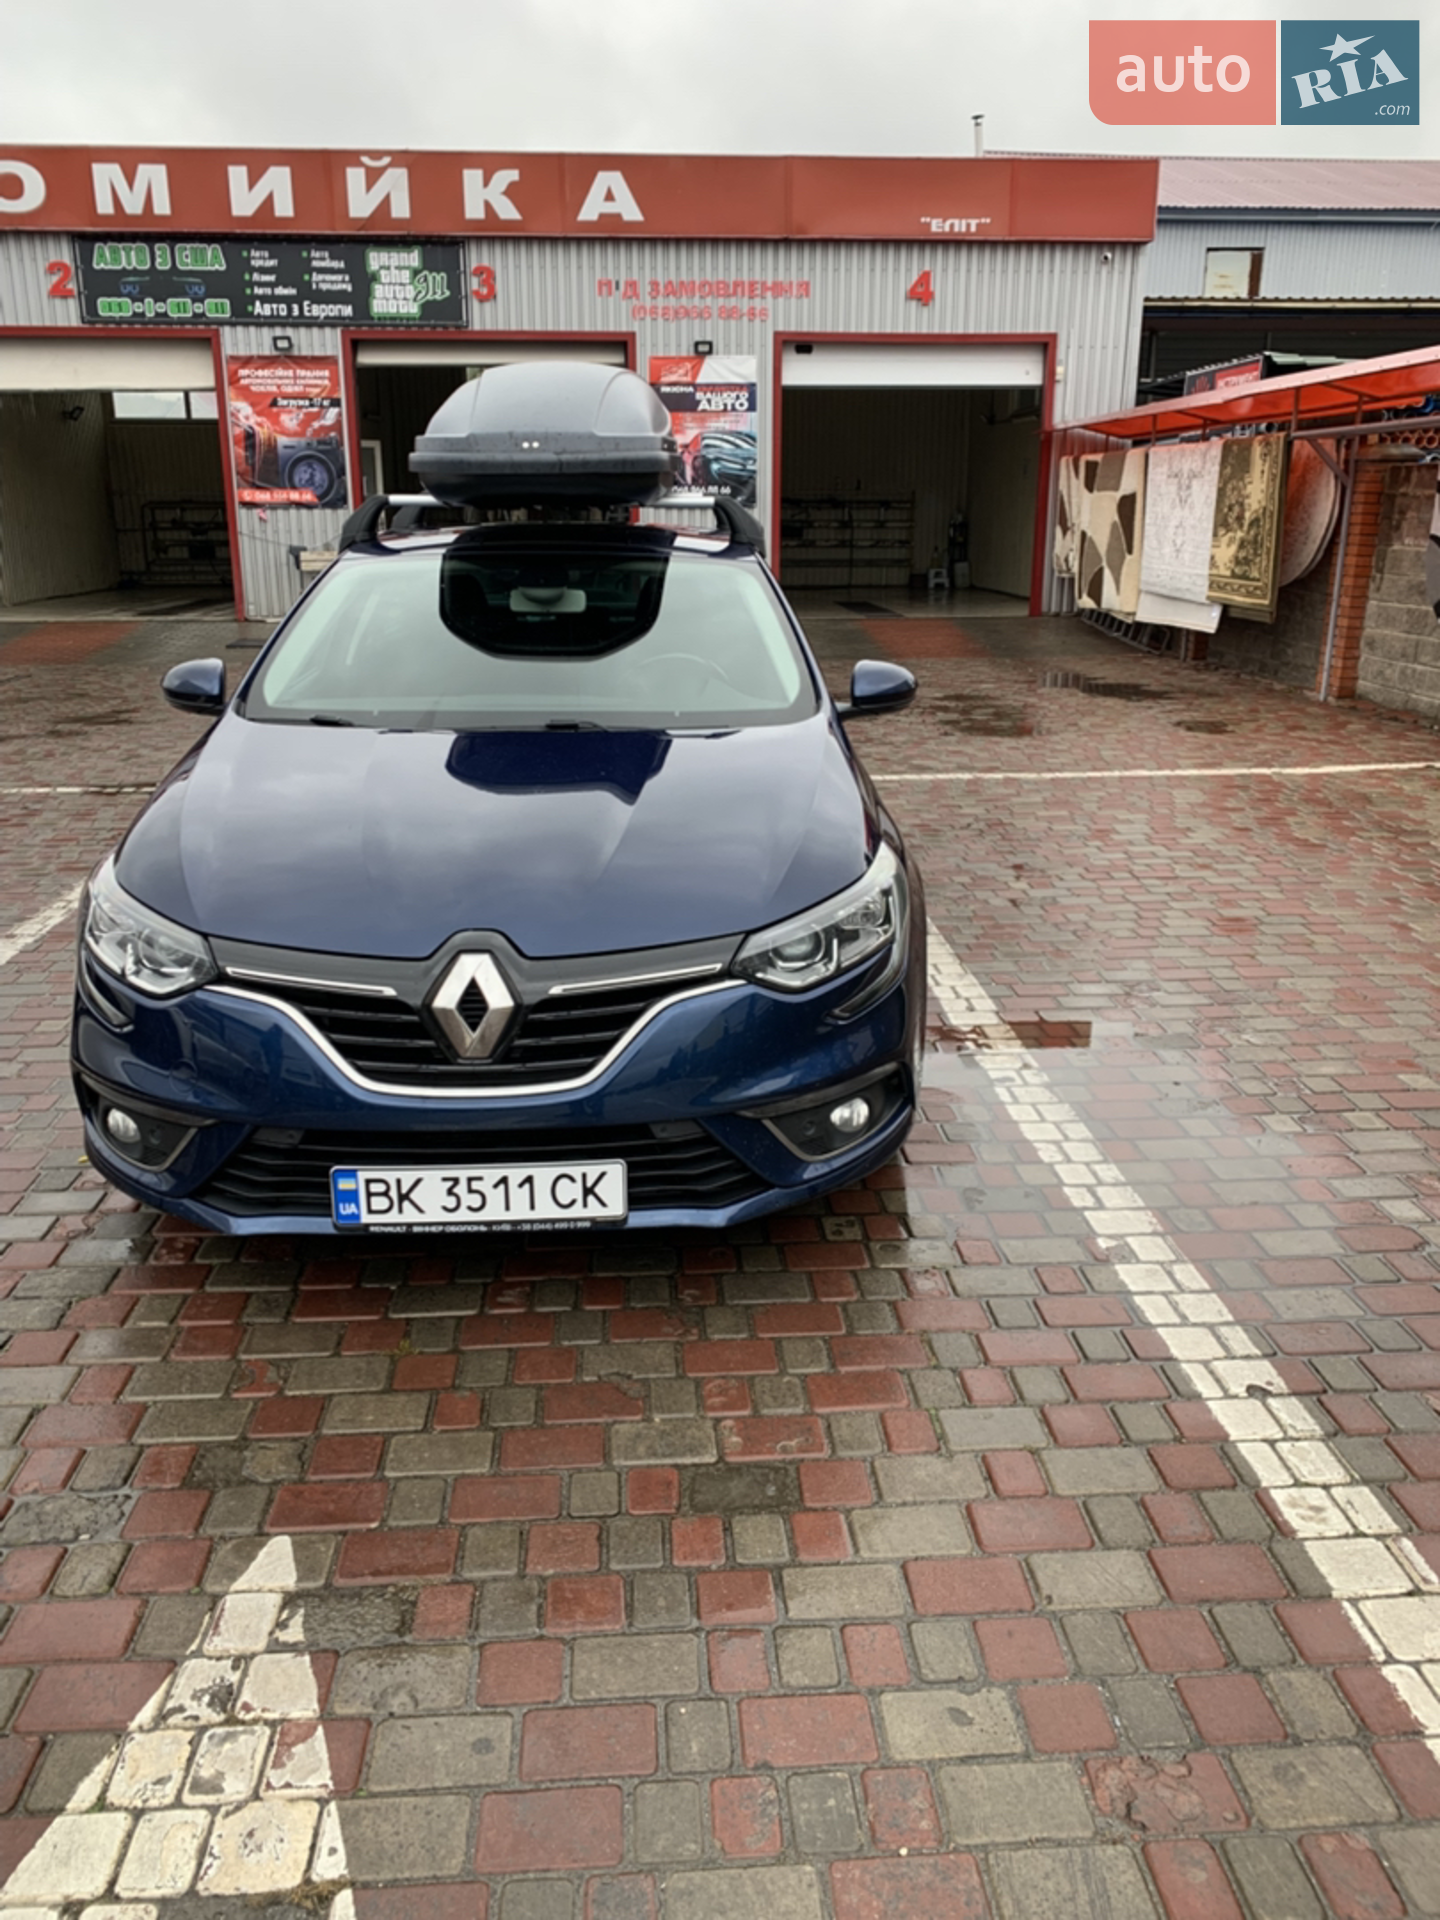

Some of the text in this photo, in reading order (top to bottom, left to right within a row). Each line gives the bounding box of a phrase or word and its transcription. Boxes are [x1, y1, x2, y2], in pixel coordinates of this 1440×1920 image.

[93, 243, 150, 270] АВТО
[175, 243, 226, 271] США
[368, 248, 419, 270] grand
[46, 260, 75, 299] 2
[380, 264, 409, 284] the
[470, 264, 497, 302] 3
[374, 284, 416, 299] auto
[648, 278, 811, 299] ЗАМОВЛЕННЯ
[906, 268, 936, 306] 4
[254, 299, 287, 316] Авто
[696, 391, 749, 401] ВАШОГО
[697, 400, 749, 412] АВТО
[364, 1171, 609, 1215] BK 3511 CK
[340, 1203, 358, 1215] UA
[369, 1225, 407, 1233] RENAULT
